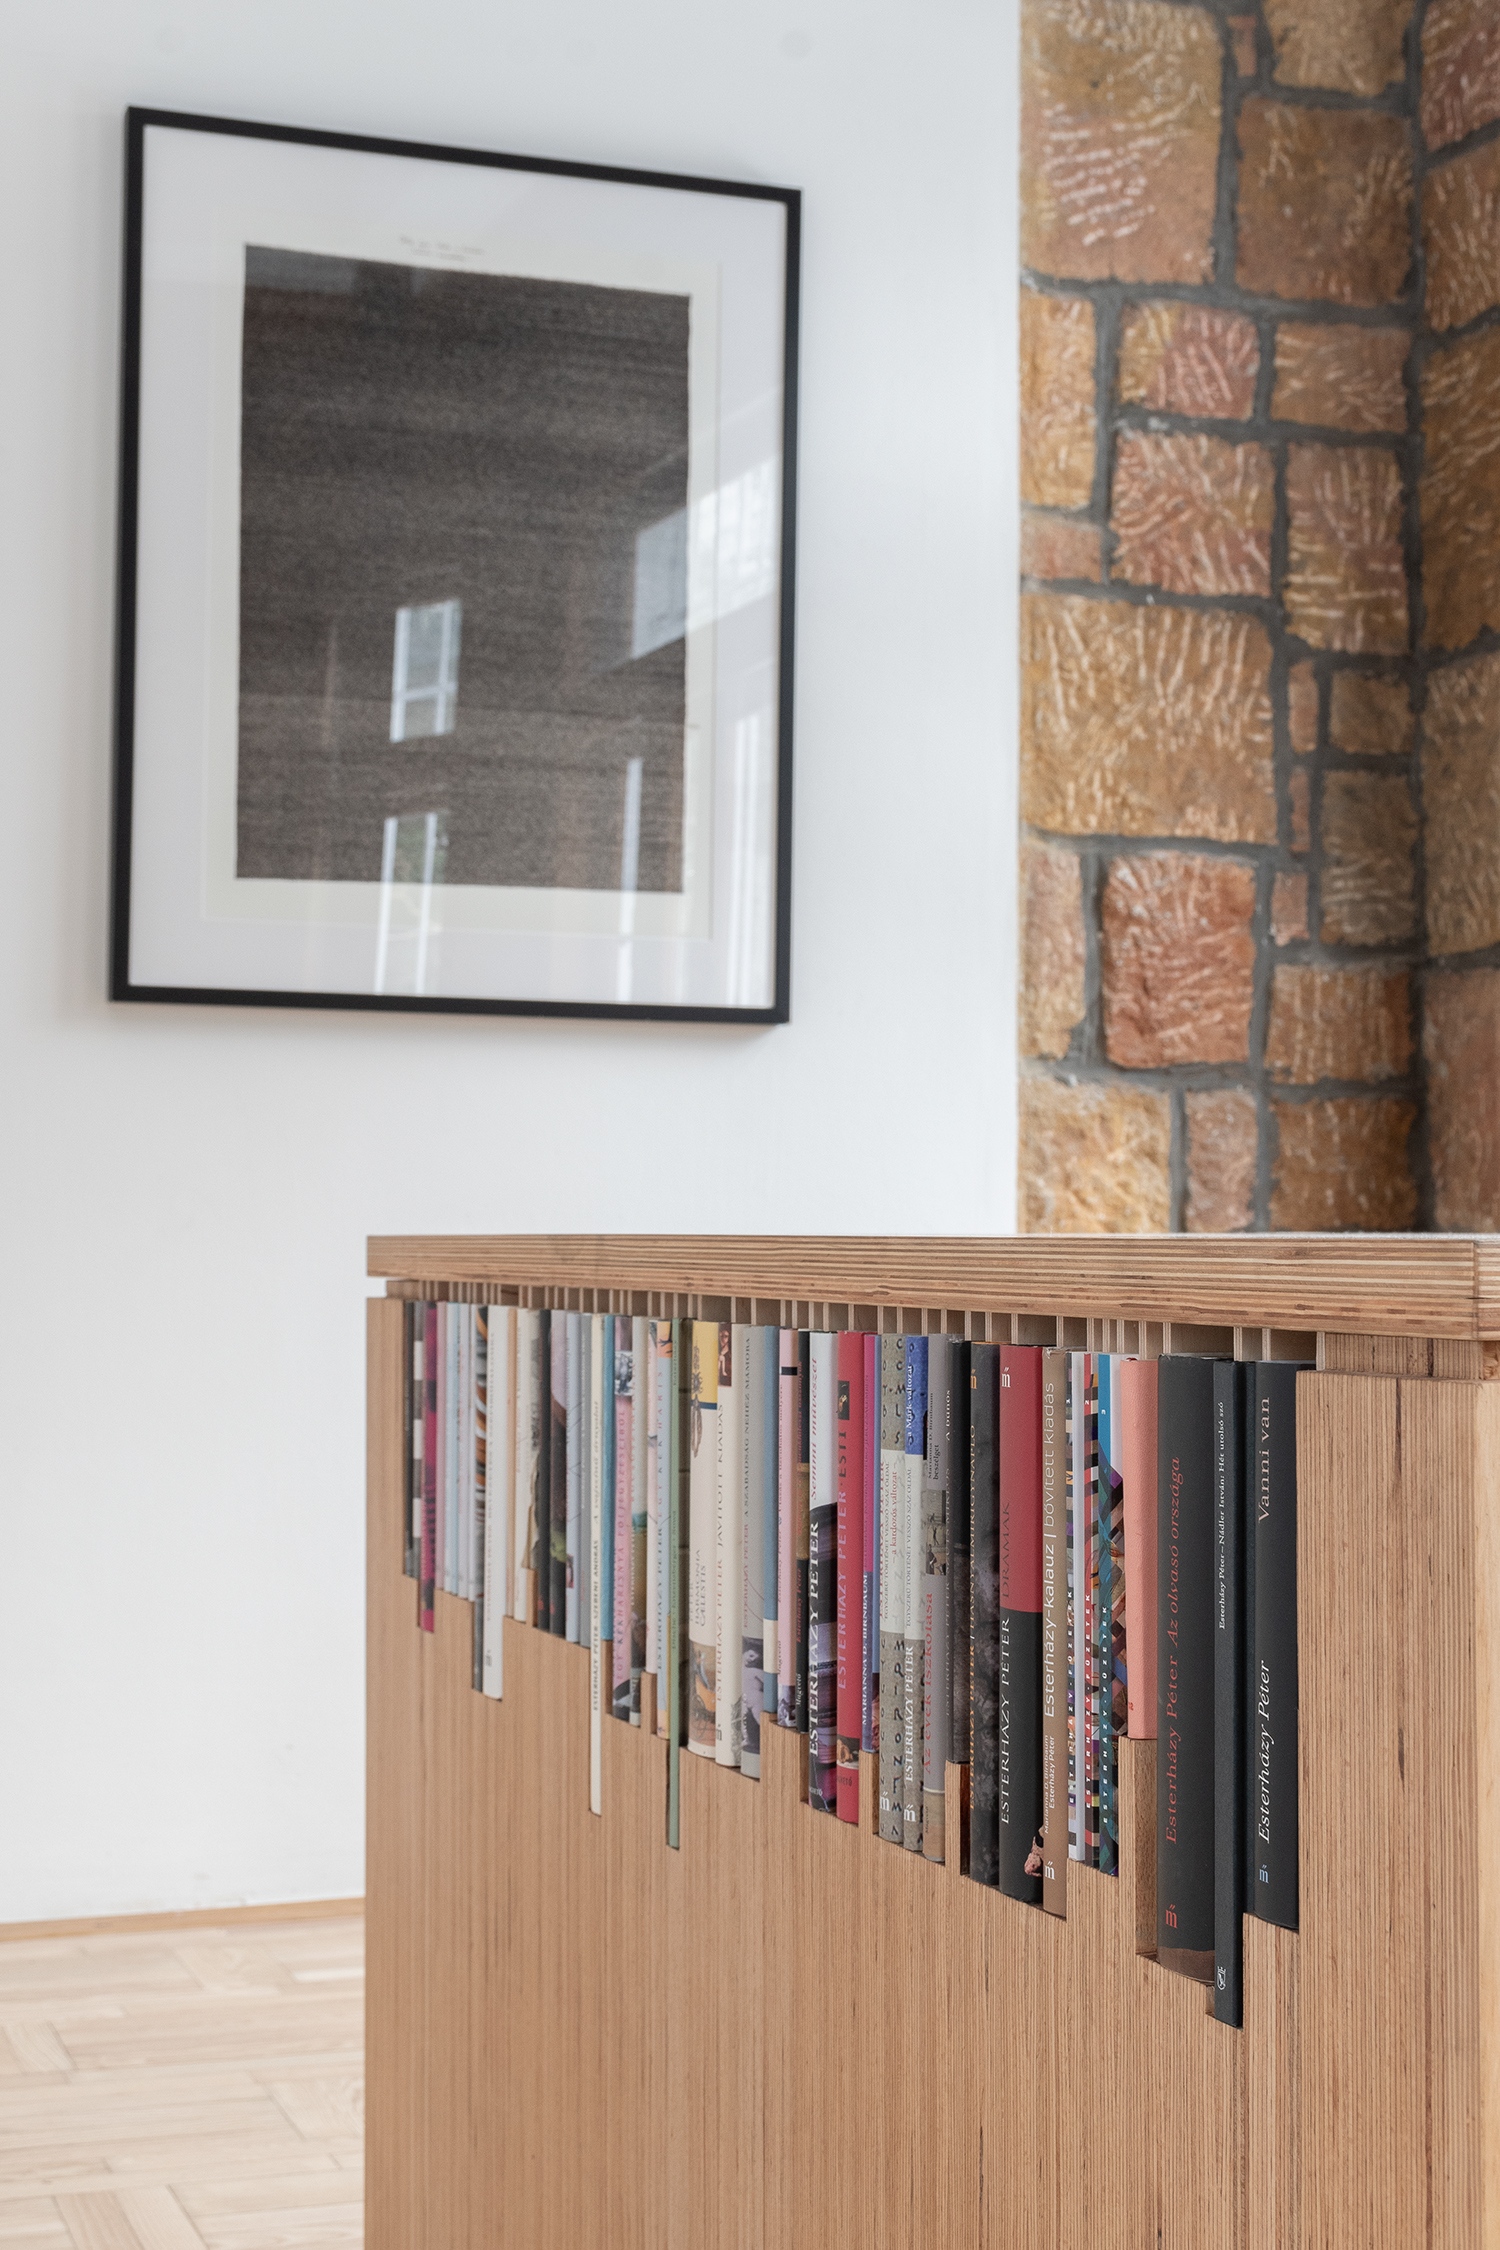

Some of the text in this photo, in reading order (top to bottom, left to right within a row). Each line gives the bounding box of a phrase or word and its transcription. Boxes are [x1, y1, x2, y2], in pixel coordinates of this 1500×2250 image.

[1043, 1382, 1055, 1445] kiadás
[1216, 1401, 1225, 1417] szó
[1216, 1420, 1225, 1450] utolsó
[932, 1445, 940, 1480] beszélget
[1217, 1453, 1226, 1472] Hét
[1258, 1397, 1271, 1524] Vanni van
[1043, 1450, 1055, 1528] bővített
[1043, 1544, 1057, 1718] Esterházy-kalauz
[1218, 1582, 1228, 1630] Esterházy
[1165, 1456, 1184, 1845] Esterházy Péter Az olvasó országa
[1258, 1659, 1275, 1845] Esterházy Péter
[1048, 1763, 1057, 1809] Esterházy
